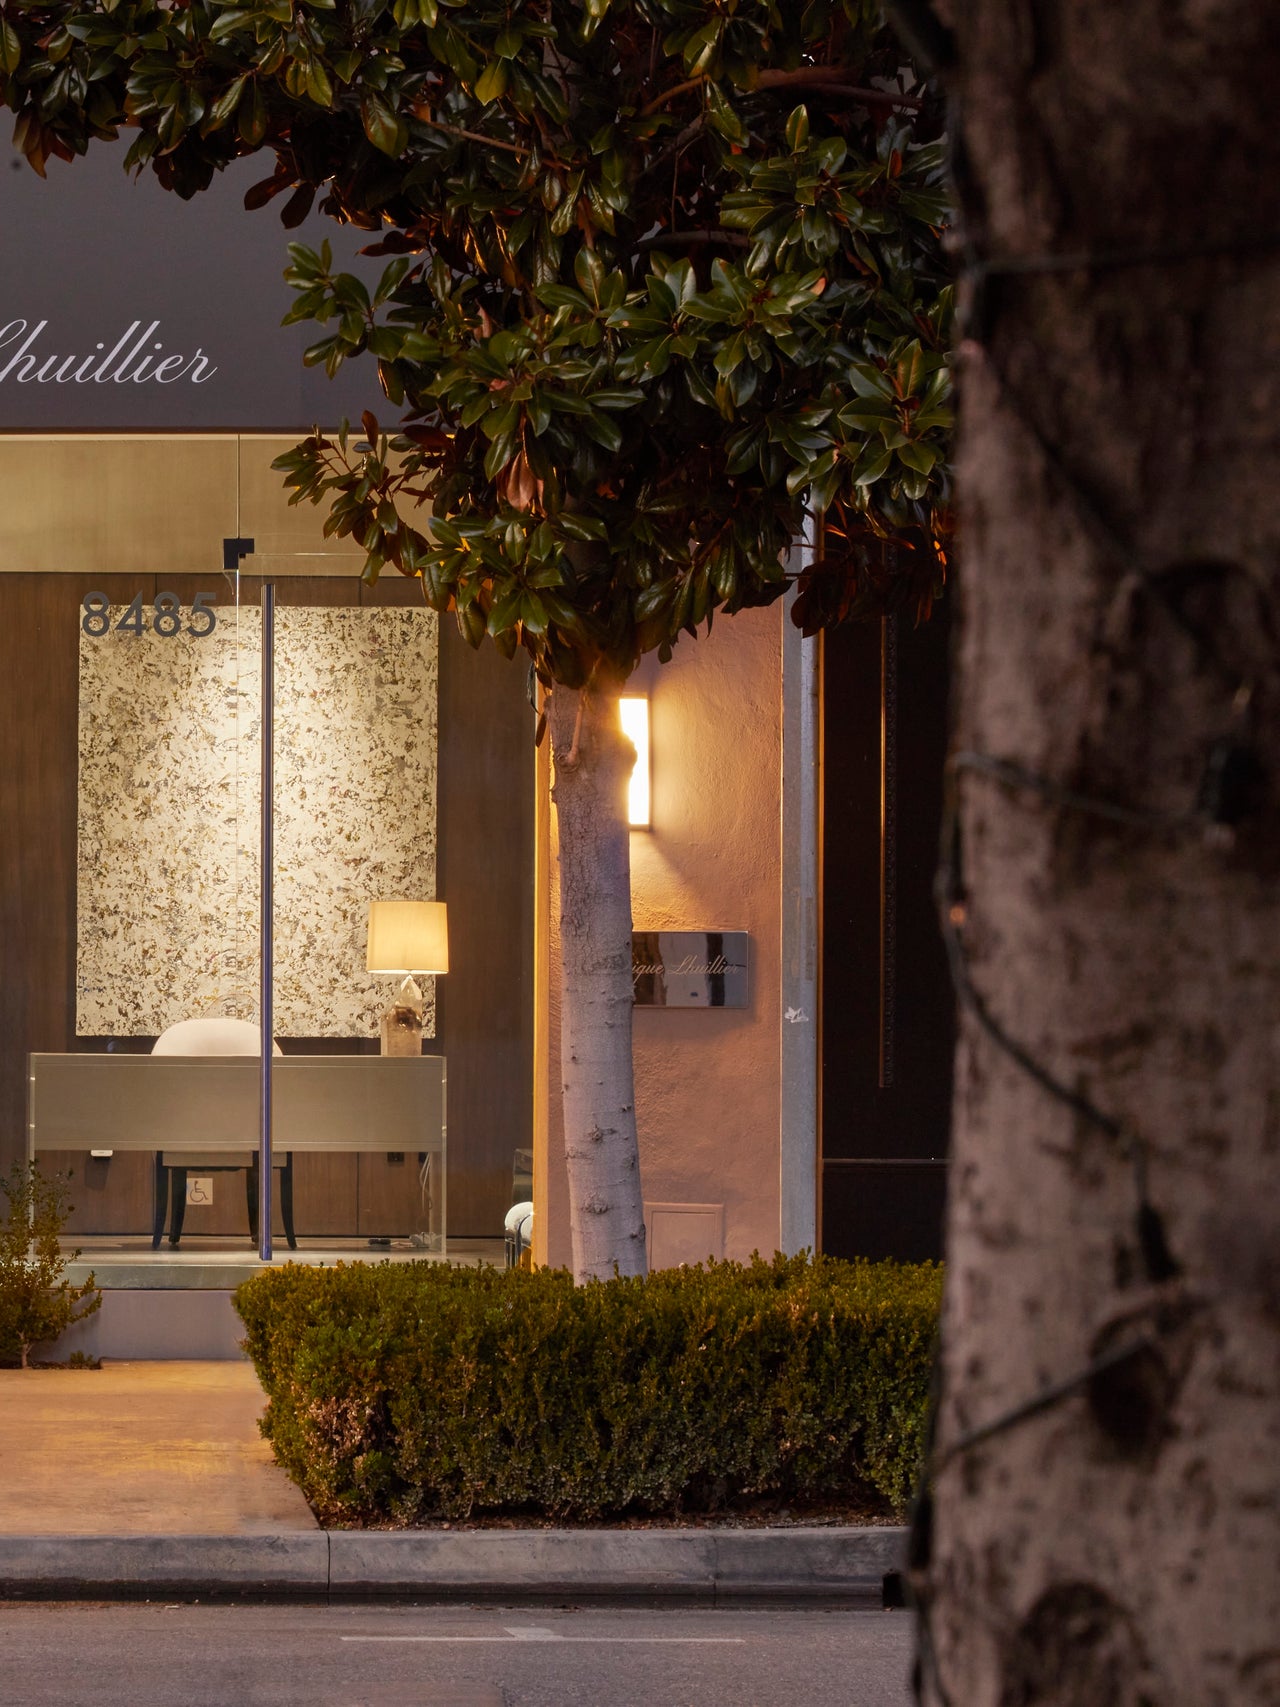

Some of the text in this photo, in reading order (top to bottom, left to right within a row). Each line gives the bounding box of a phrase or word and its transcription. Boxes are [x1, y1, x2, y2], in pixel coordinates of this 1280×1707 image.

[82, 590, 217, 638] 8485
[632, 954, 740, 985] ique Lhuillier
